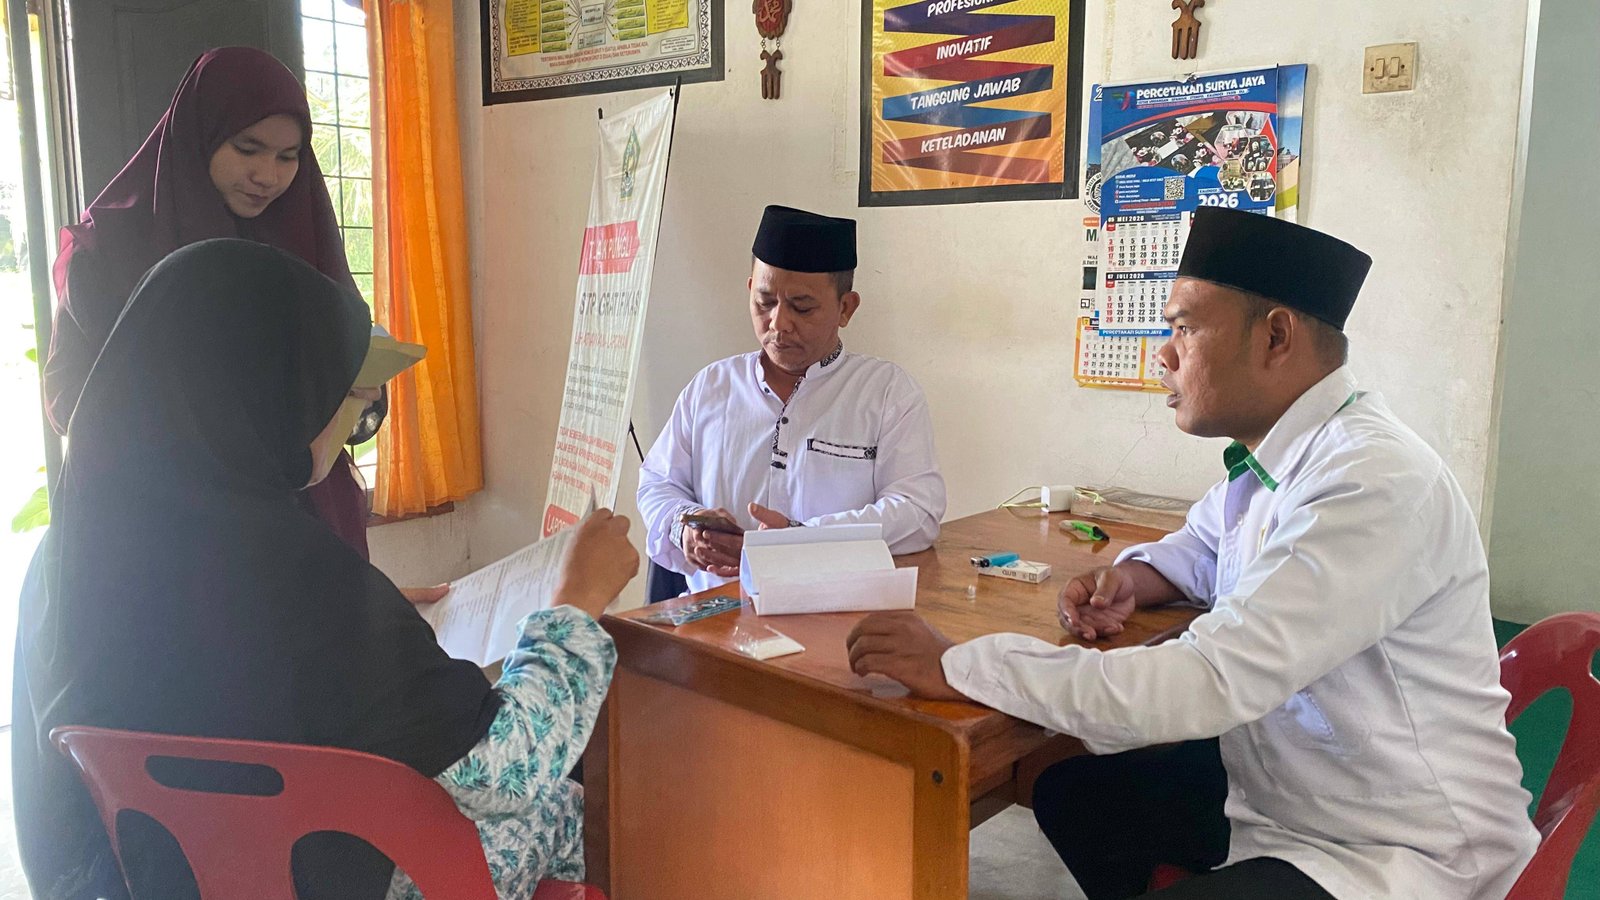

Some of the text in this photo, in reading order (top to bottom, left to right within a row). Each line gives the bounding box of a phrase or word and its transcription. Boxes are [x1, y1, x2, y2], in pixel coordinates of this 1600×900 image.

[936, 35, 993, 60] INOVATIF
[910, 78, 1021, 110] TANGGUNG JAWAB
[1206, 80, 1238, 92] SURYA
[1239, 75, 1265, 89] JAYA
[920, 127, 1006, 153] KETELADANAN
[1198, 193, 1239, 208] 2026
